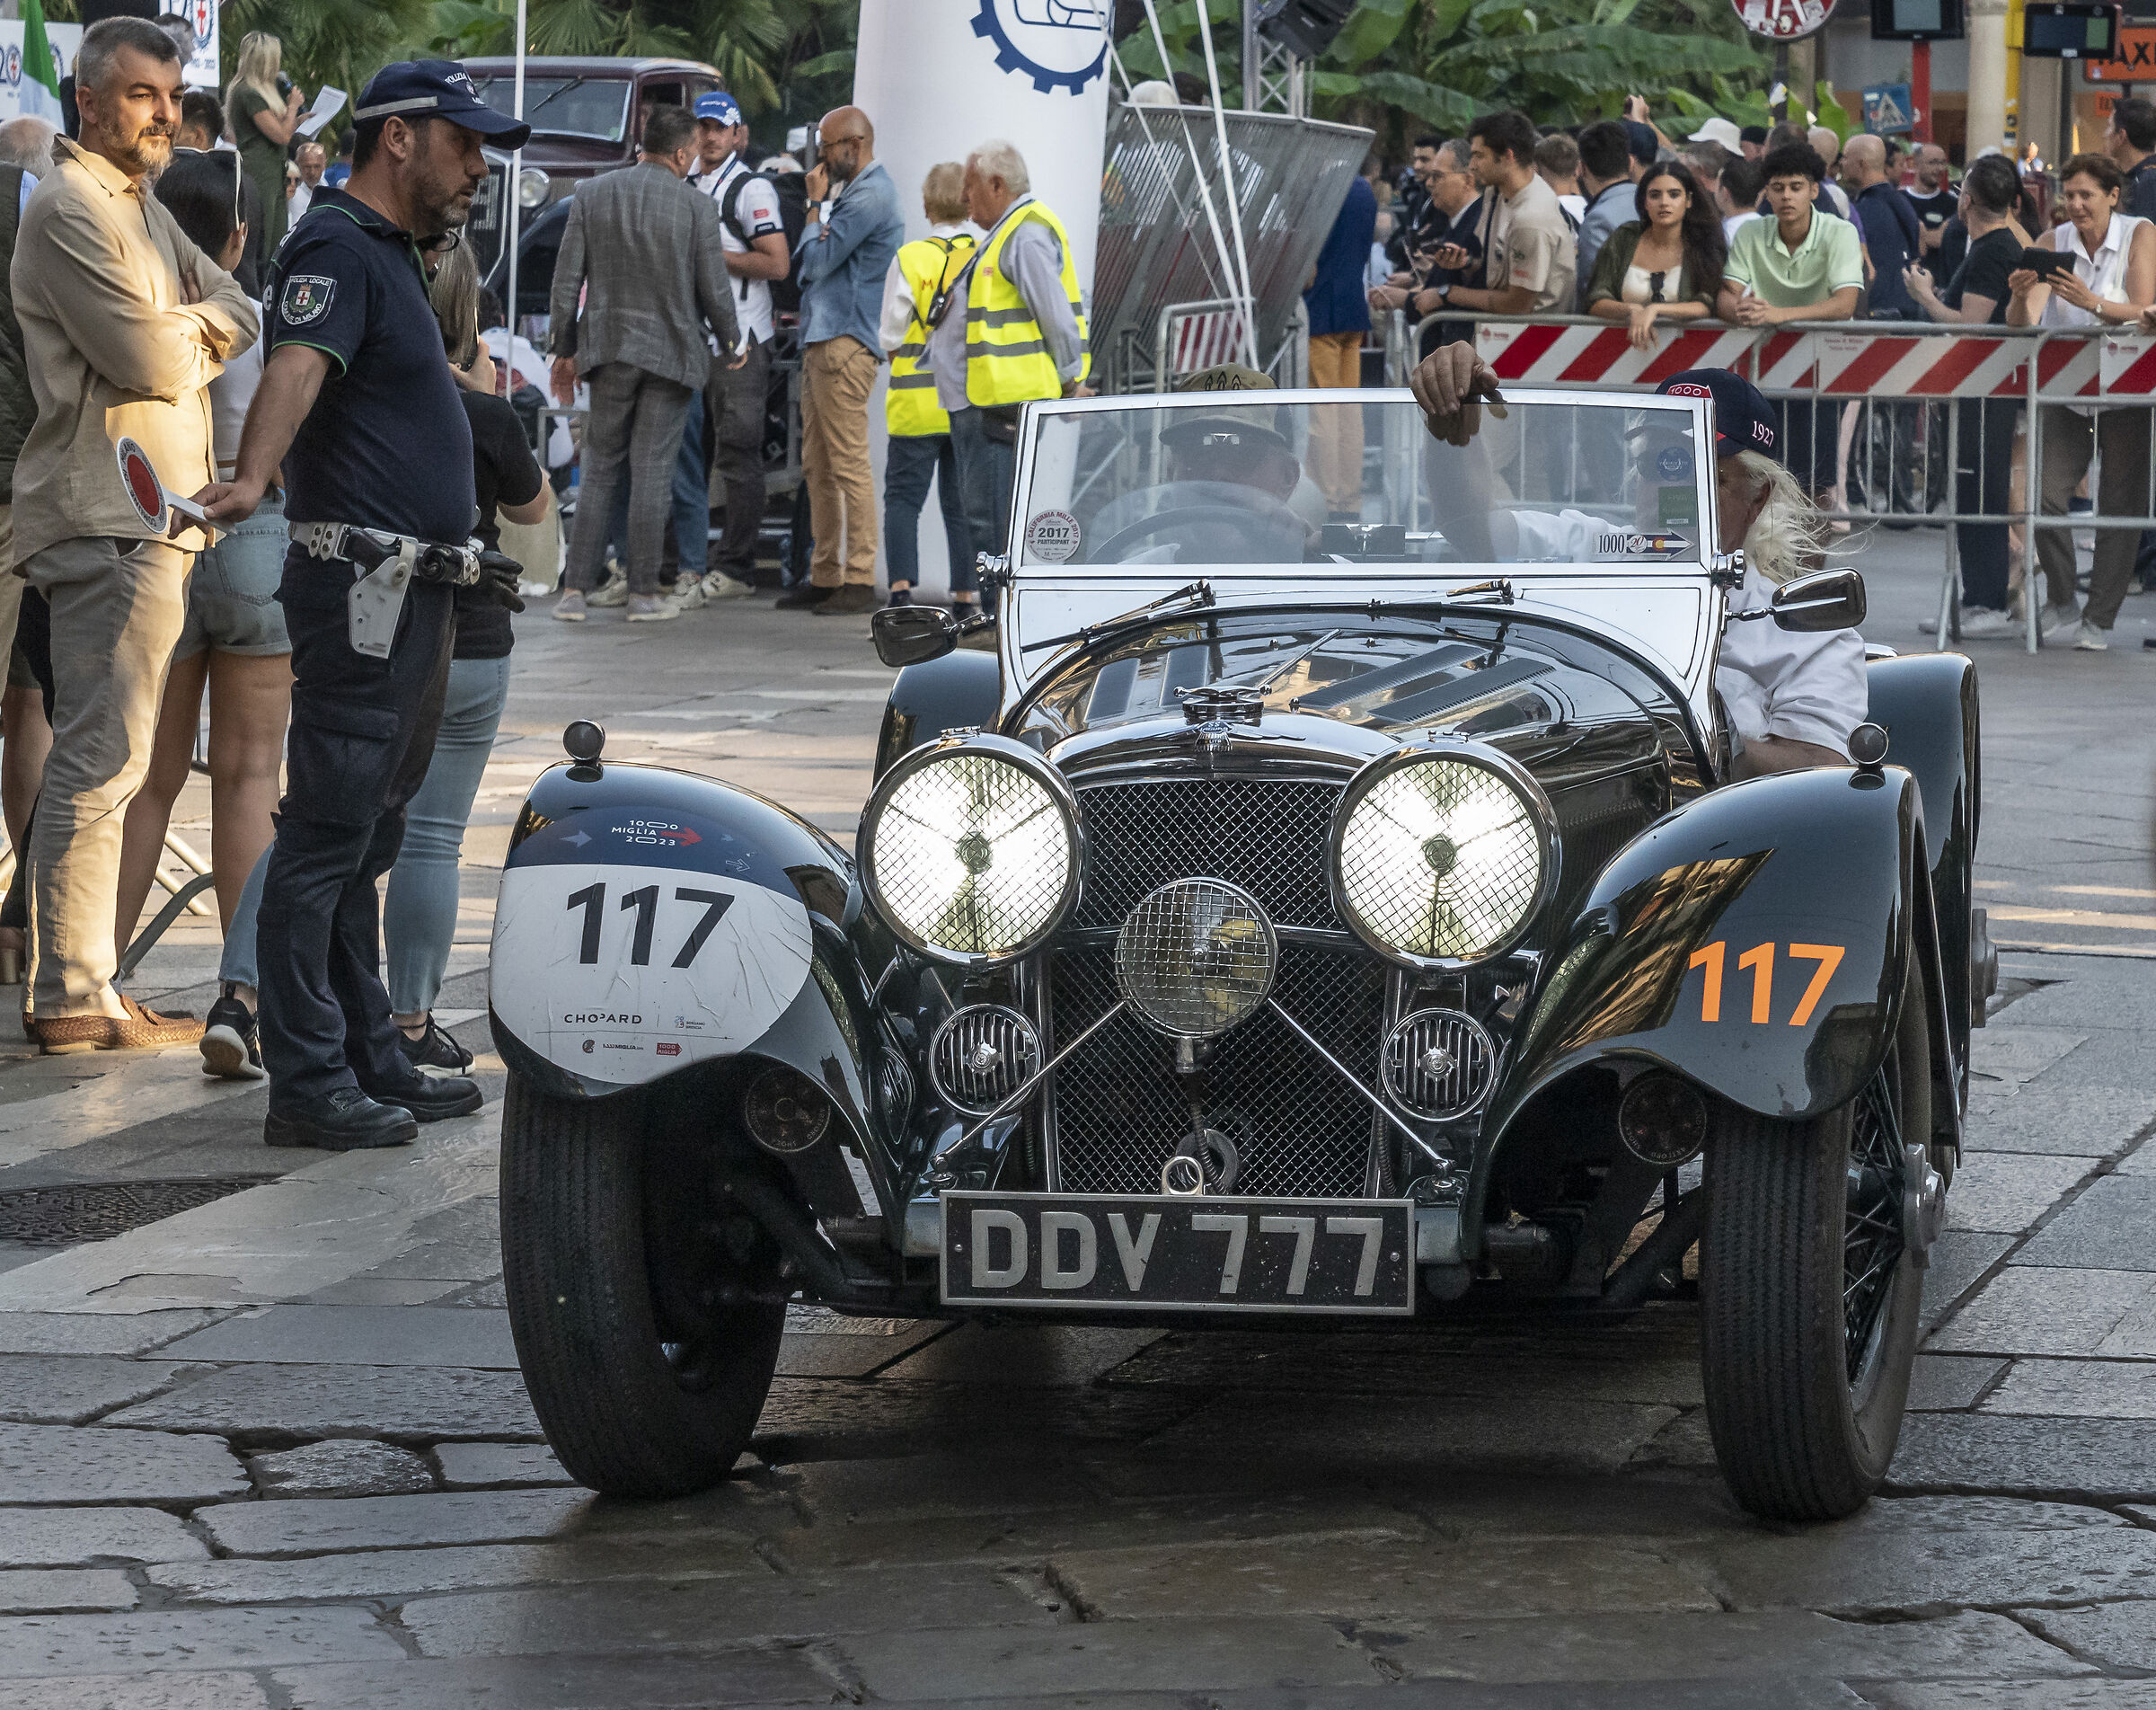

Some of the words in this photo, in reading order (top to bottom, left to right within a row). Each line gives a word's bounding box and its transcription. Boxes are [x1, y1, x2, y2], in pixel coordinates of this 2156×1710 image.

[2099, 42, 2156, 66] AX
[444, 72, 467, 84] POLIZIA
[308, 278, 331, 287] LOCALE
[302, 303, 323, 322] MILANO
[1671, 386, 1701, 396] 1000
[1752, 421, 1774, 447] 1927
[1028, 511, 1056, 538] CALIFORNIA
[1056, 511, 1074, 525] MILLE
[1071, 523, 1079, 538] 2017
[1038, 527, 1070, 538] 2017
[1598, 534, 1625, 554] 1000
[611, 827, 658, 836] MIGLIA
[629, 820, 679, 830] 1000
[625, 836, 676, 846] 2023
[566, 882, 736, 969] 117
[1688, 941, 1846, 1026] 117
[564, 1013, 643, 1024] CHOPARD
[972, 1209, 1162, 1291] DDV
[1191, 1214, 1383, 1297] 777
